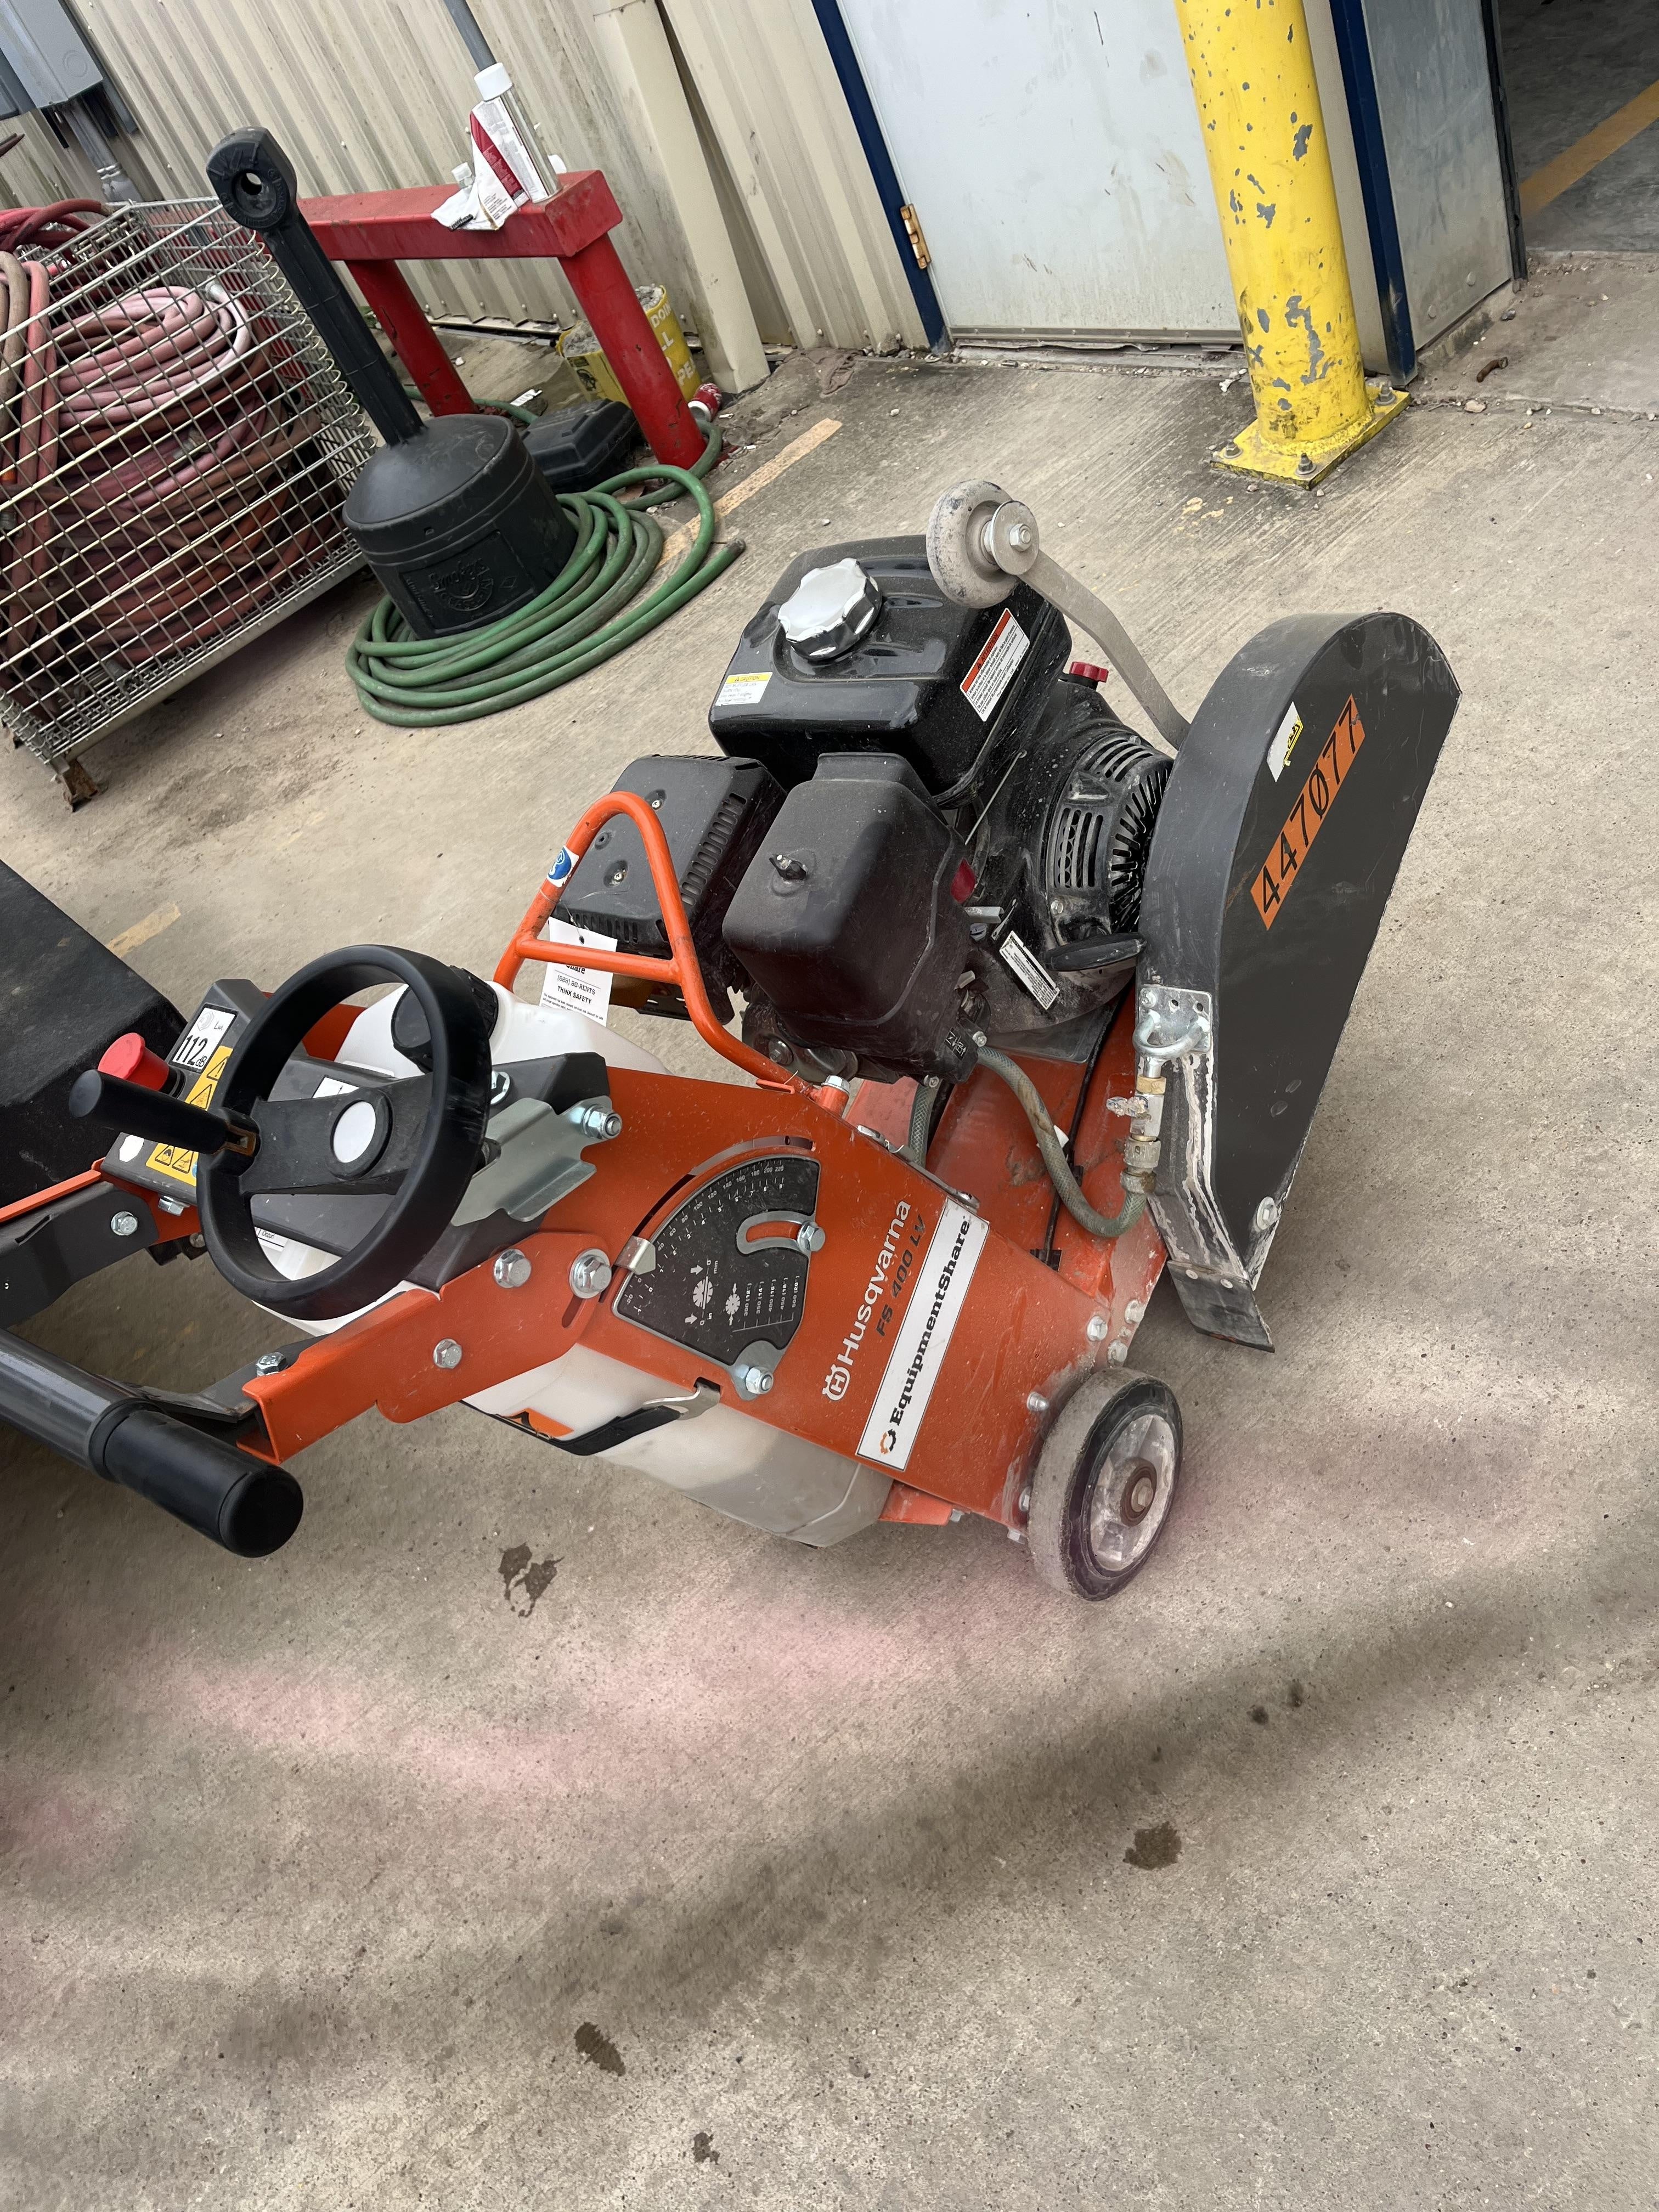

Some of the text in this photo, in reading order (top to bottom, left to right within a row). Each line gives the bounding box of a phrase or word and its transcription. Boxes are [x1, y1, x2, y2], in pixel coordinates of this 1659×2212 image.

[980, 631, 998, 662] ATTENTION
[1263, 698, 1356, 914] 447077
[557, 985, 572, 997] THINK
[573, 991, 592, 1004] SAFETY
[176, 1035, 208, 1066] 112
[195, 1055, 207, 1068] dB
[669, 1228, 676, 1236] 60
[681, 1215, 688, 1223] 80
[693, 1201, 703, 1211] 100
[708, 1190, 717, 1200] 120
[723, 1181, 732, 1190] 140
[714, 1260, 718, 1274] mm
[837, 1199, 911, 1365] Husqvarna
[876, 1214, 926, 1337] FS 400 LV
[890, 1217, 970, 1426] EquipmentShare
